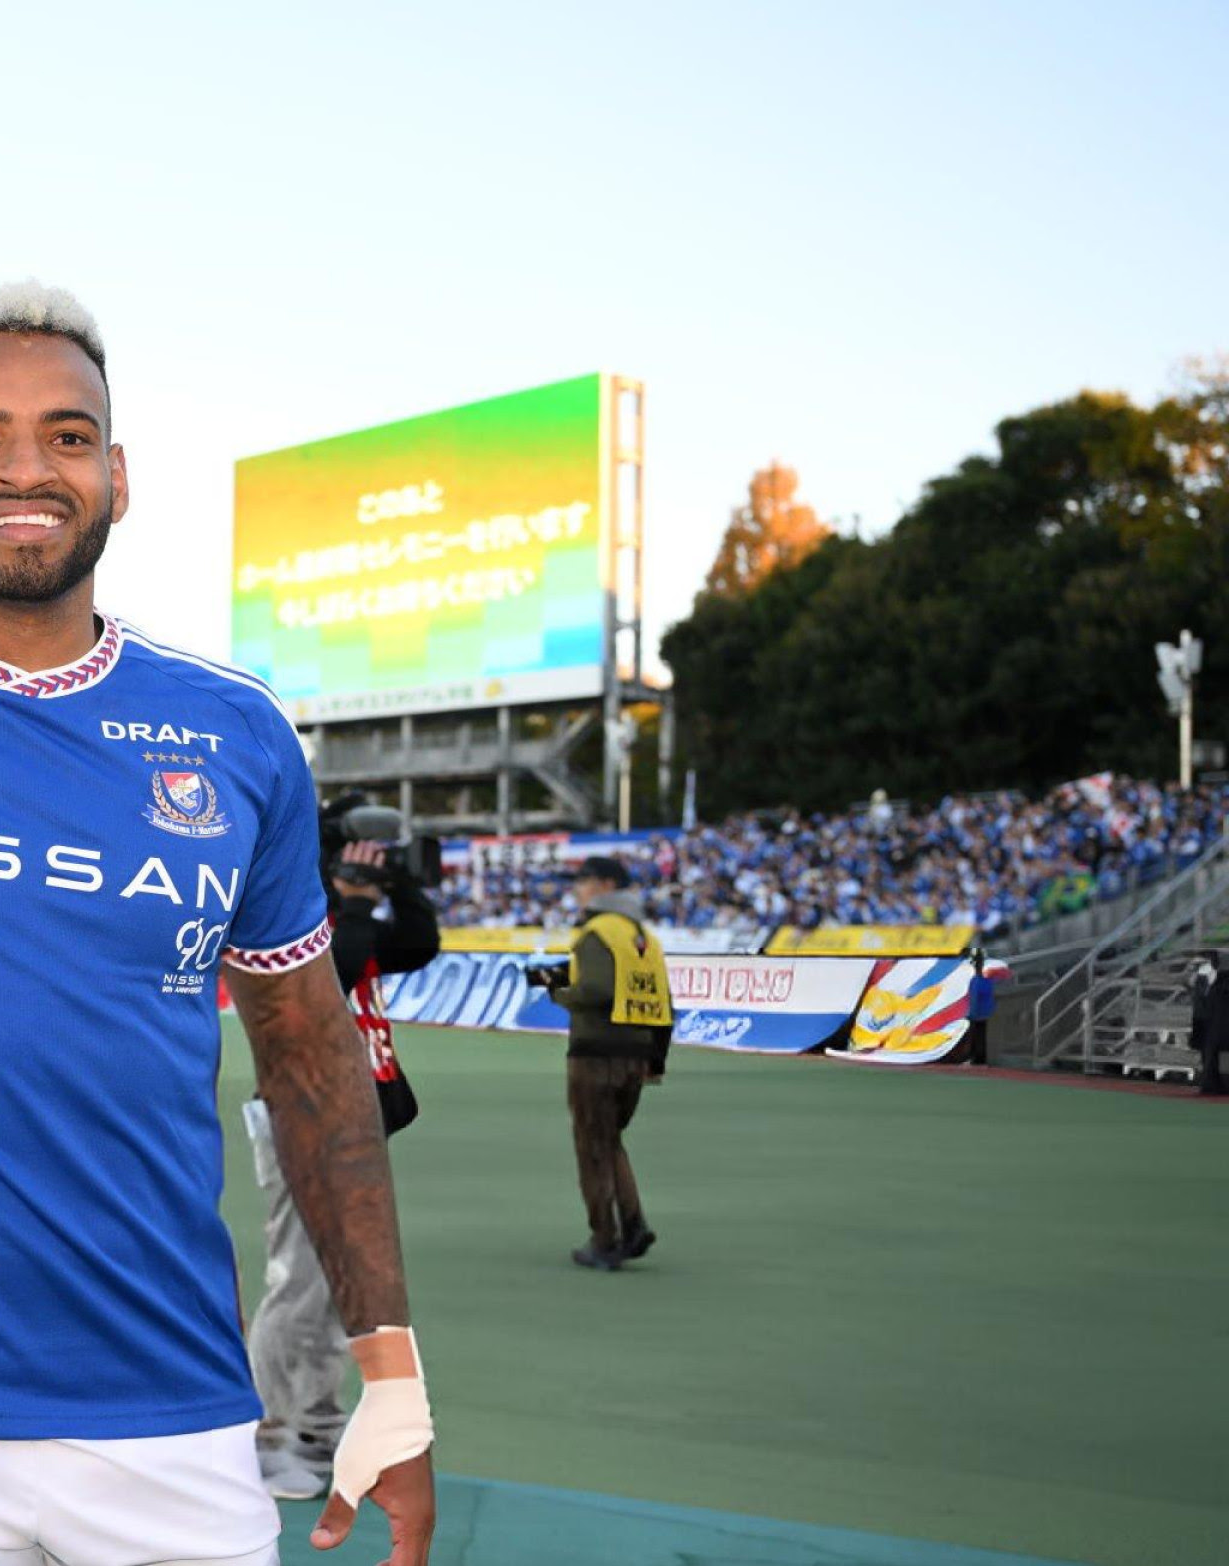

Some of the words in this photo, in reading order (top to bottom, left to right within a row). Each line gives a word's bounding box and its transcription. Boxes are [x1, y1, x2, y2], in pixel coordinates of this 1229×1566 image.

[101, 720, 224, 753] DRAFT
[176, 917, 229, 971] 90
[163, 973, 205, 985] NISSAN
